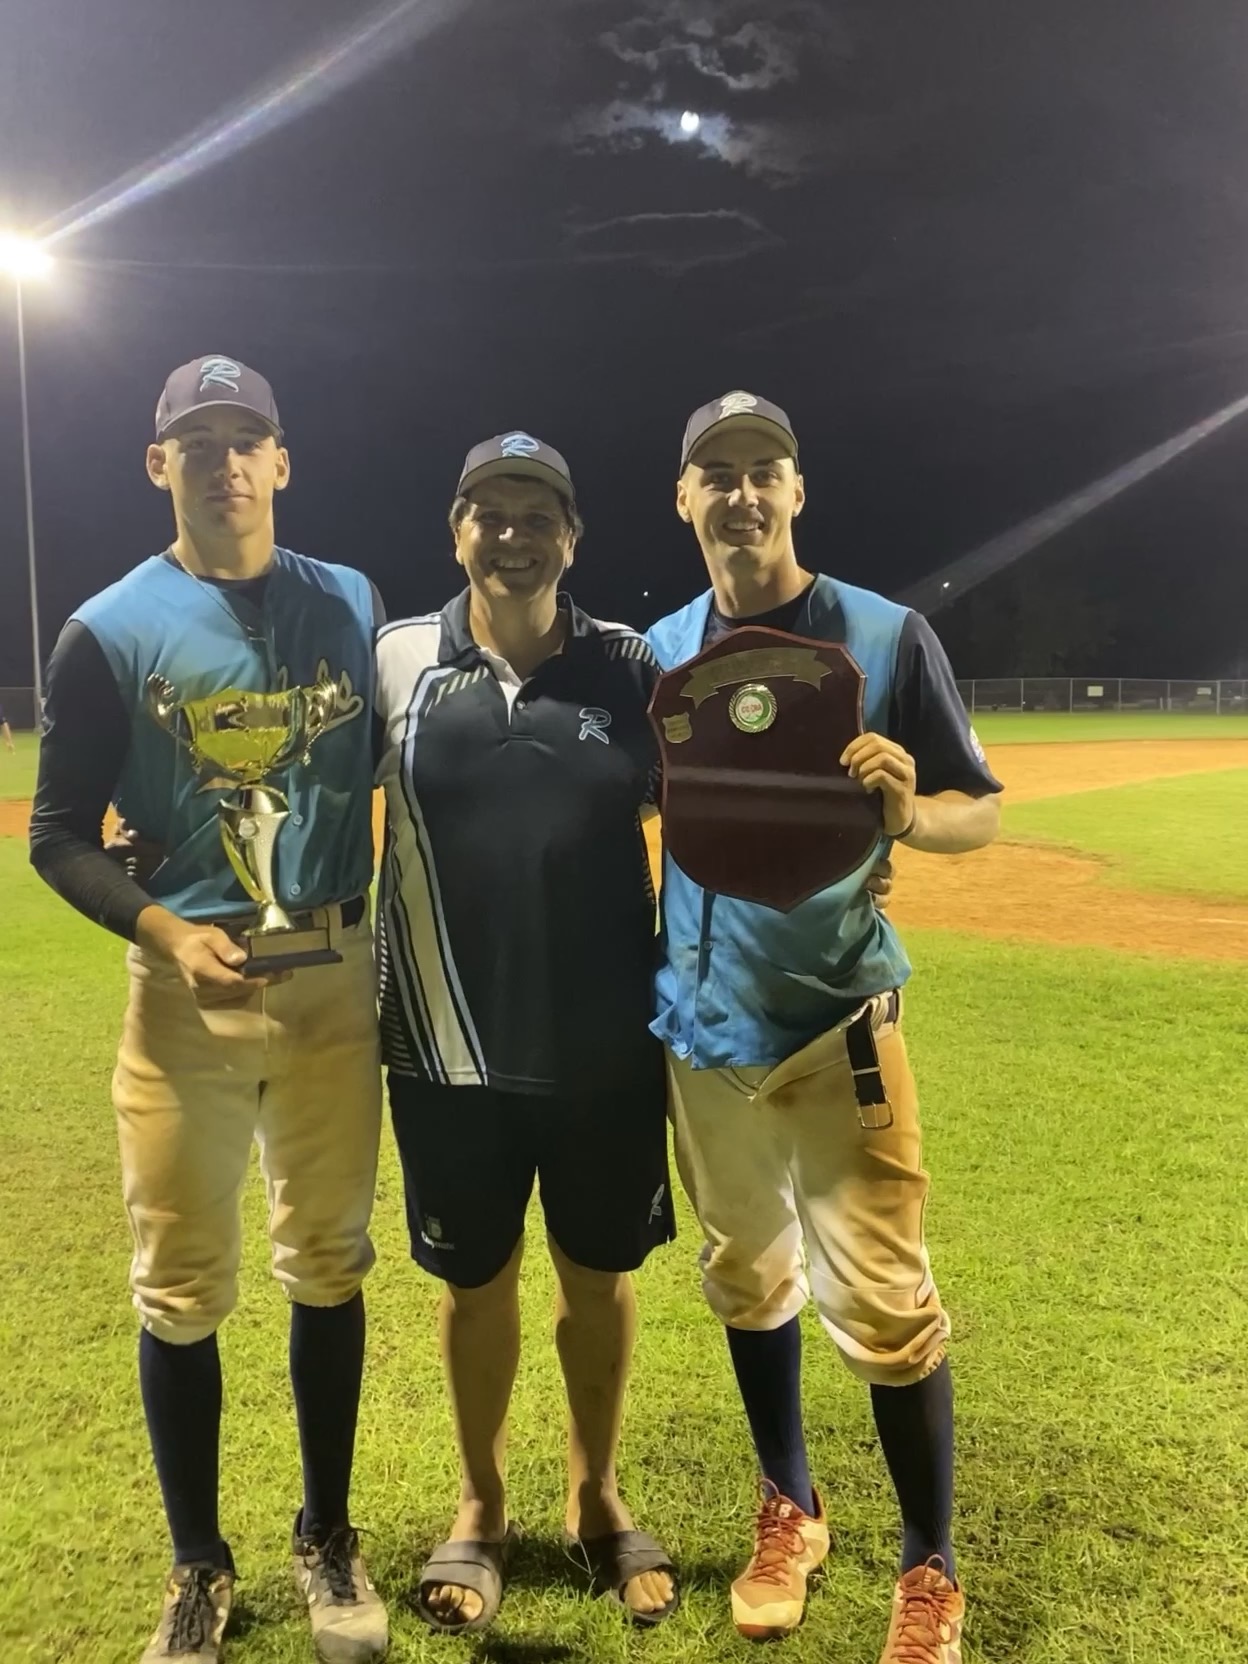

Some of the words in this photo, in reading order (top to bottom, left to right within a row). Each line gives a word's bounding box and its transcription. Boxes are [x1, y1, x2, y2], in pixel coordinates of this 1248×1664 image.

[200, 358, 241, 393] R
[719, 392, 758, 420] R
[500, 434, 540, 458] R
[578, 707, 612, 745] R
